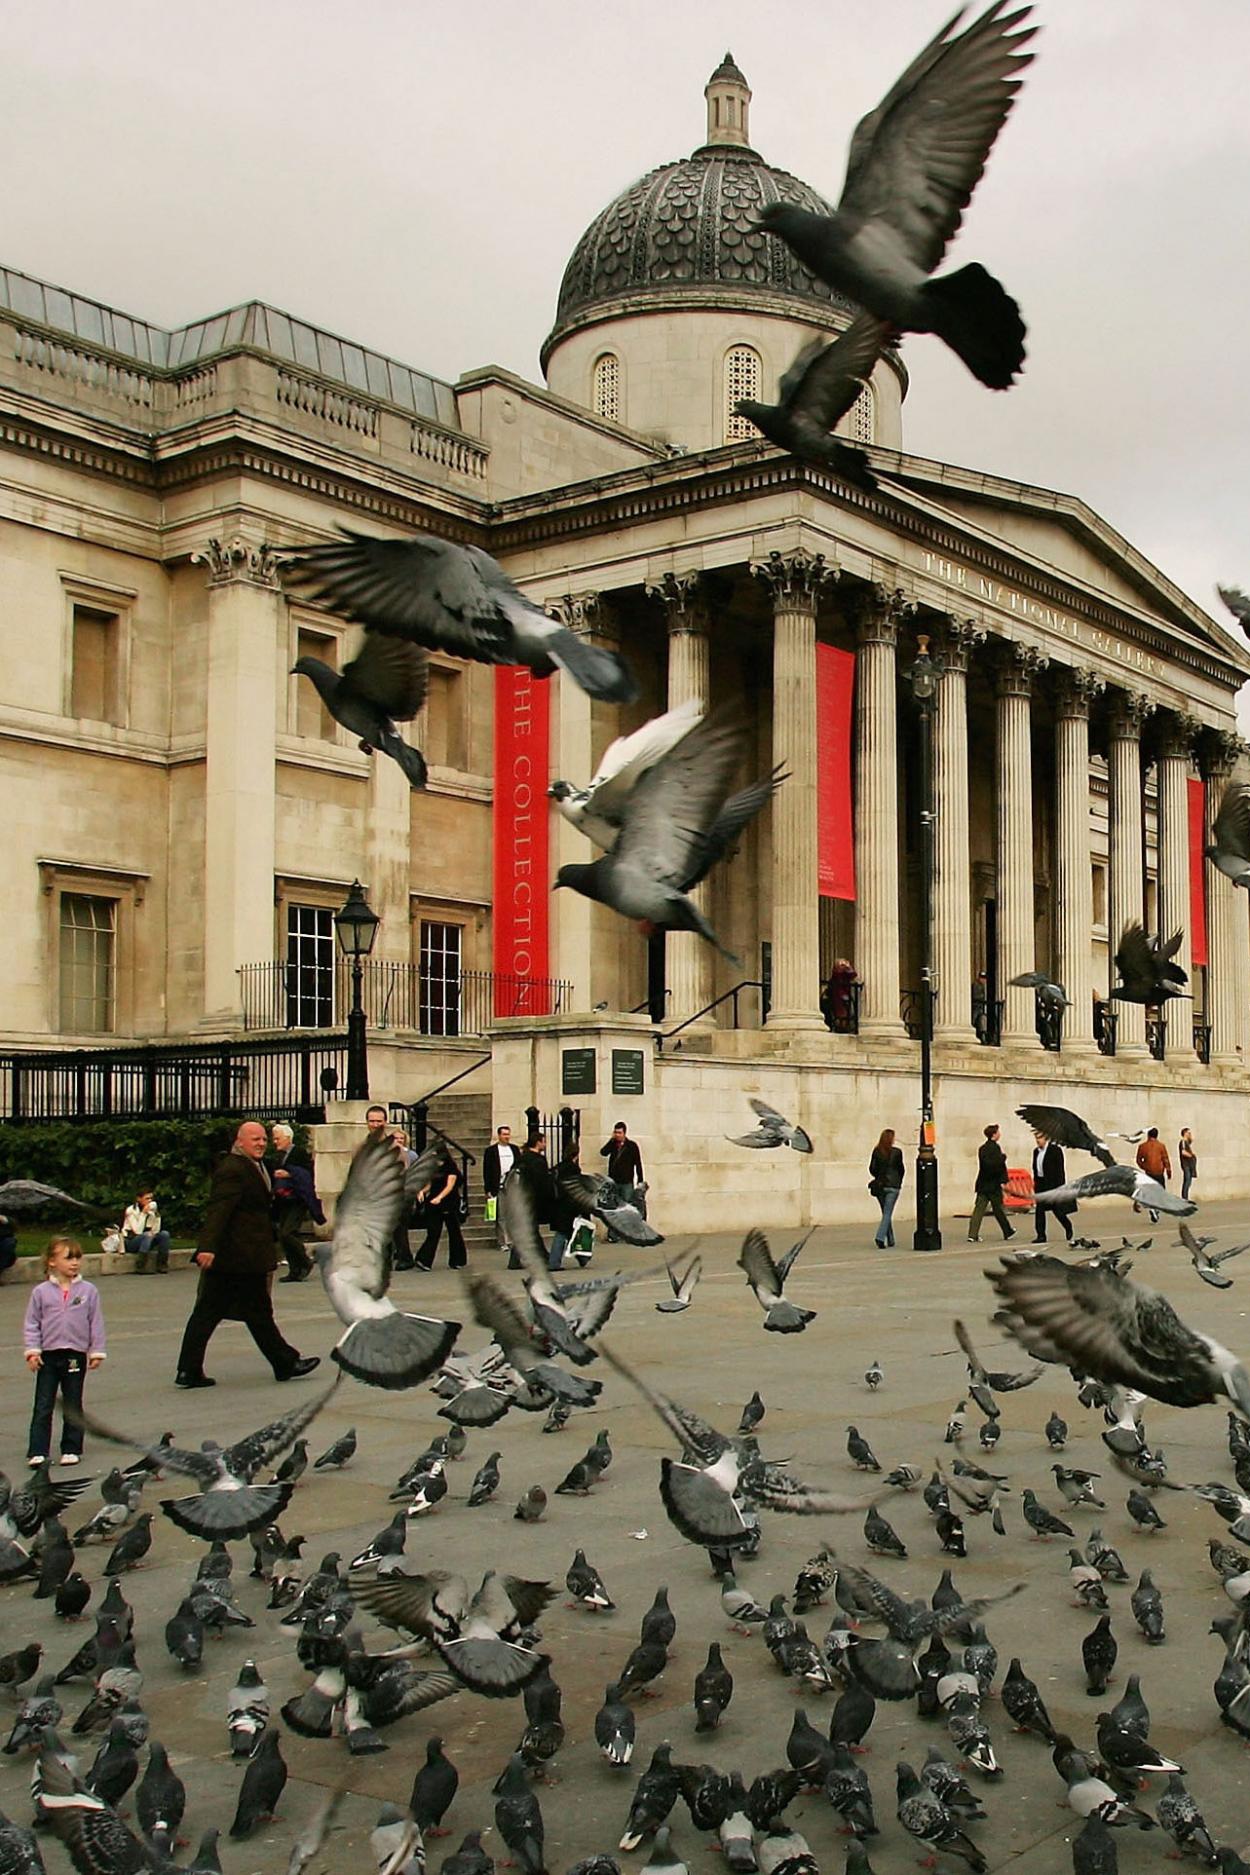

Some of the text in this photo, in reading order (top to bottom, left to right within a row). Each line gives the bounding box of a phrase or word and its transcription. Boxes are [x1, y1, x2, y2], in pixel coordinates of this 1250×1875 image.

[921, 551, 1166, 677] THE NATIONAL GALLERY
[513, 667, 531, 1008] THE COLLECTION
